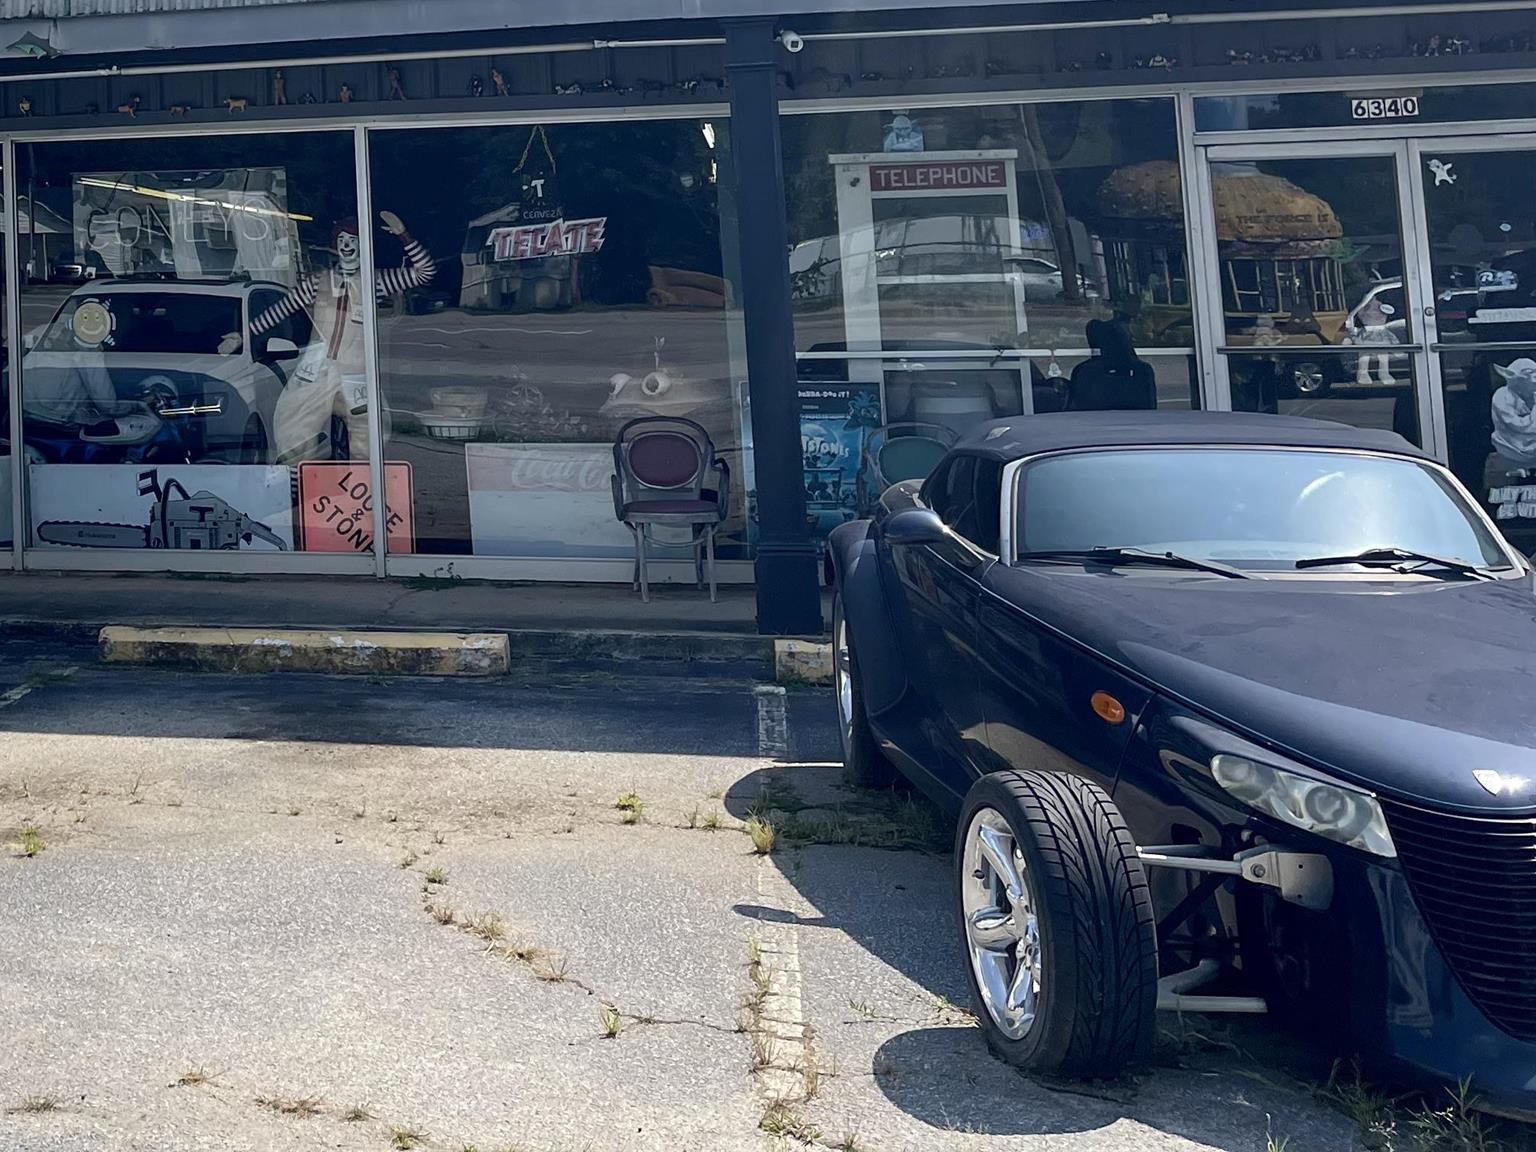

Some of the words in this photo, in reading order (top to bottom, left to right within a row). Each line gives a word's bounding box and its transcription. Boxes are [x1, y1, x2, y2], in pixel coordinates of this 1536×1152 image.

[1352, 97, 1418, 118] 6340
[875, 165, 1001, 188] TELEPHONE
[485, 216, 607, 262] TECATE
[338, 471, 404, 534] LOE
